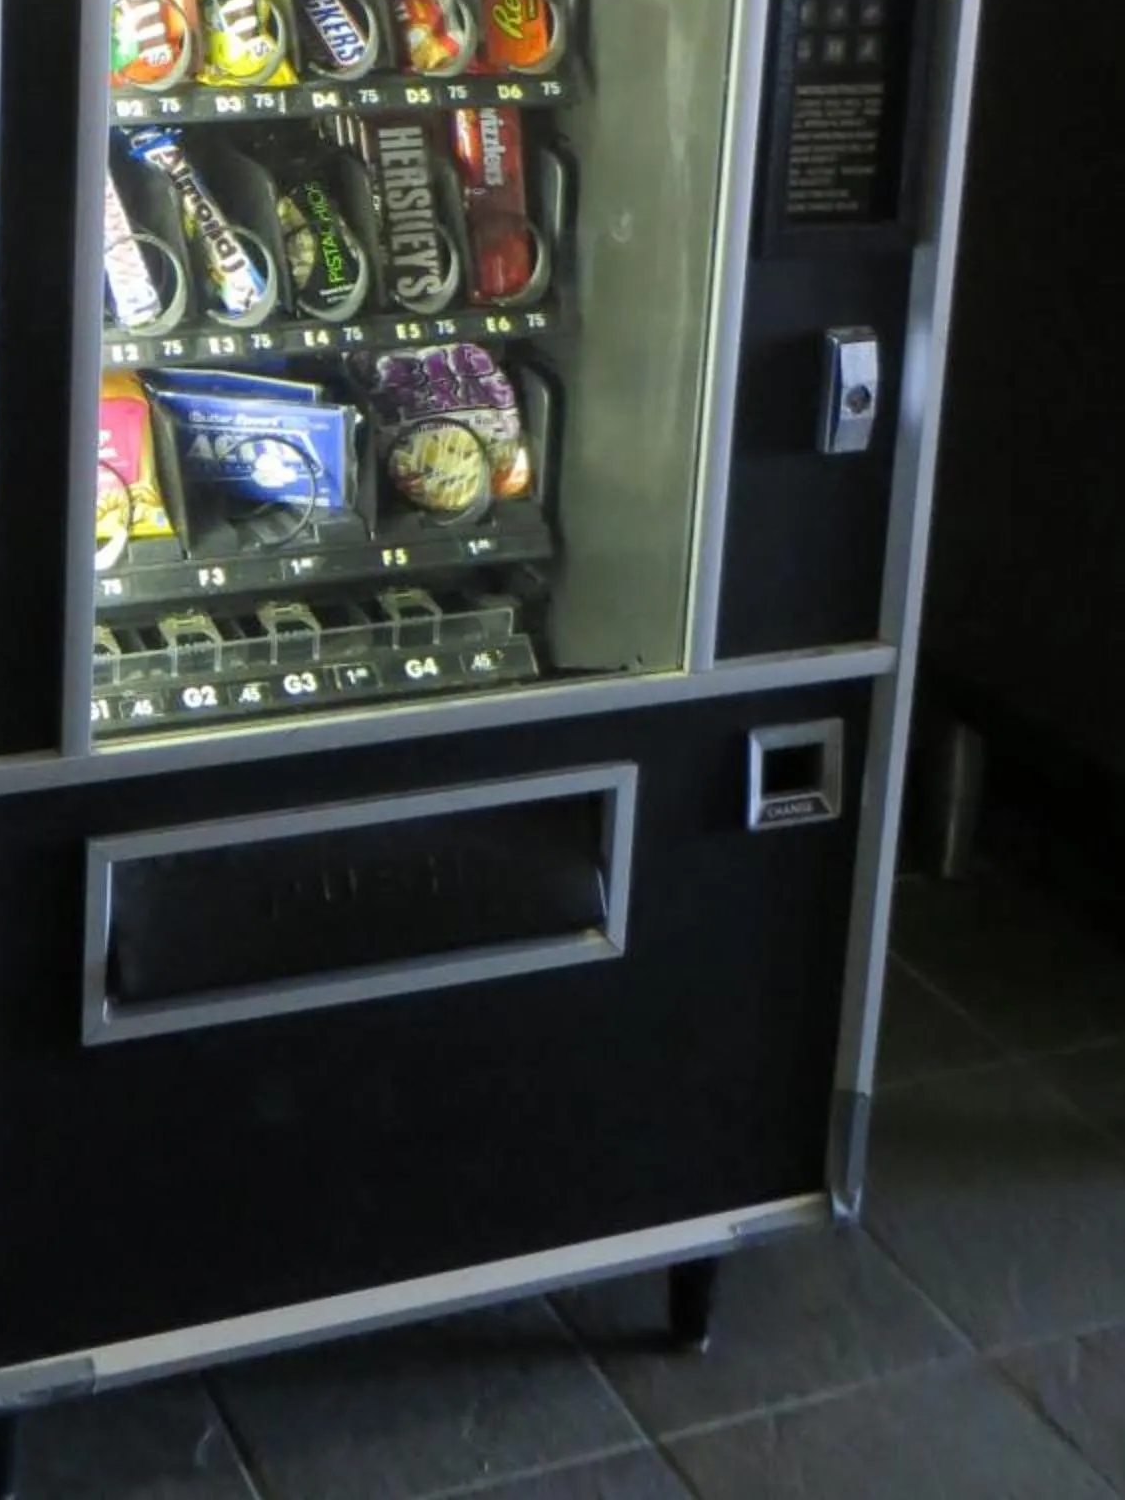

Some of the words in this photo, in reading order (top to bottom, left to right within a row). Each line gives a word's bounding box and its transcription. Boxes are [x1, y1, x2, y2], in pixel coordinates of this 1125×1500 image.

[358, 88, 379, 104] 75
[405, 88, 432, 104] D5
[447, 84, 469, 100] 75
[497, 83, 524, 100] D6
[541, 81, 562, 96] 75
[159, 98, 181, 113] 75
[216, 96, 242, 112] D3
[254, 93, 275, 109] 75
[312, 91, 338, 108] D4
[116, 100, 144, 118] D2
[377, 126, 443, 298] HERSHEY'S
[435, 319, 456, 335] 75
[486, 316, 512, 333] E6
[526, 313, 547, 329] 75
[304, 330, 330, 347] E4
[342, 327, 364, 342] 75
[395, 322, 422, 341] E5
[162, 340, 183, 356] 75
[209, 336, 236, 354] E3
[251, 333, 273, 349] 75
[112, 344, 139, 362] E2
[382, 548, 408, 566] F5
[198, 568, 226, 587] F3
[404, 657, 440, 679] G4
[283, 671, 318, 695] G3
[182, 685, 218, 708] G2
